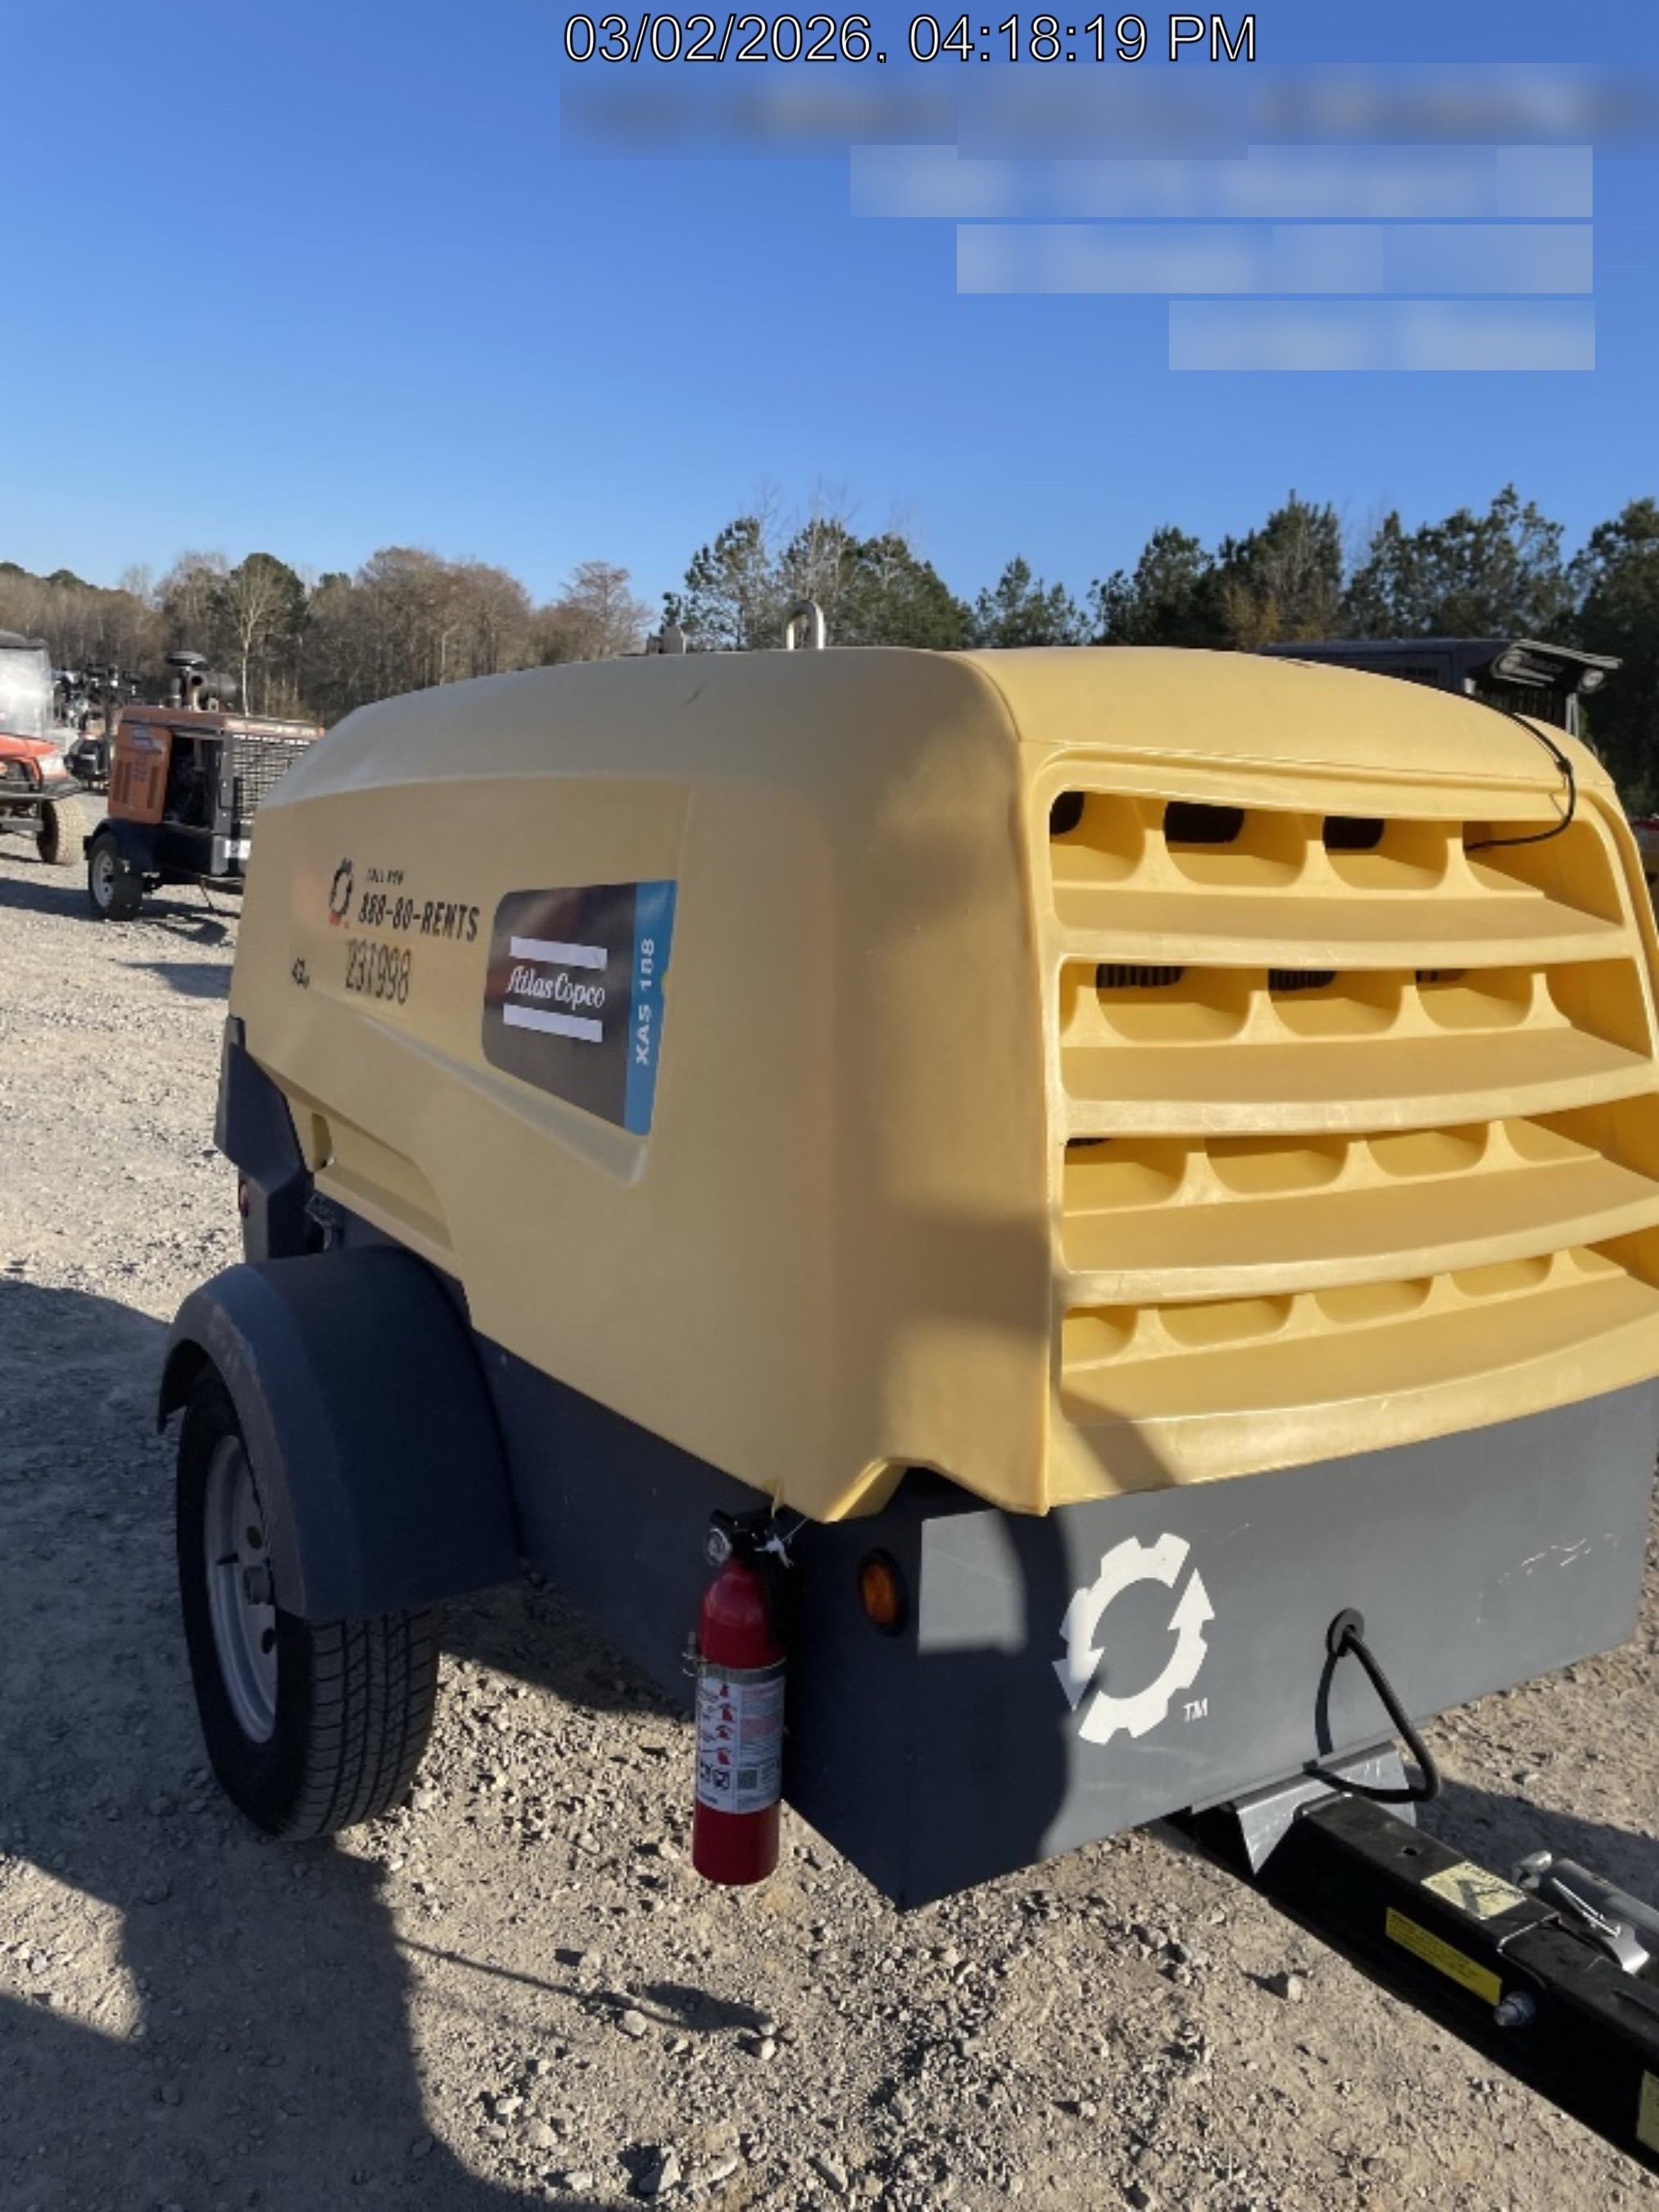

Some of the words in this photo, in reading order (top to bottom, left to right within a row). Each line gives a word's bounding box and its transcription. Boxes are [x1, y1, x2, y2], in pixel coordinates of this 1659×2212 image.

[505, 964, 553, 999] Atlas
[554, 972, 606, 1011] Copco
[635, 1004, 653, 1066] XAS
[1181, 1697, 1208, 1724] TM
